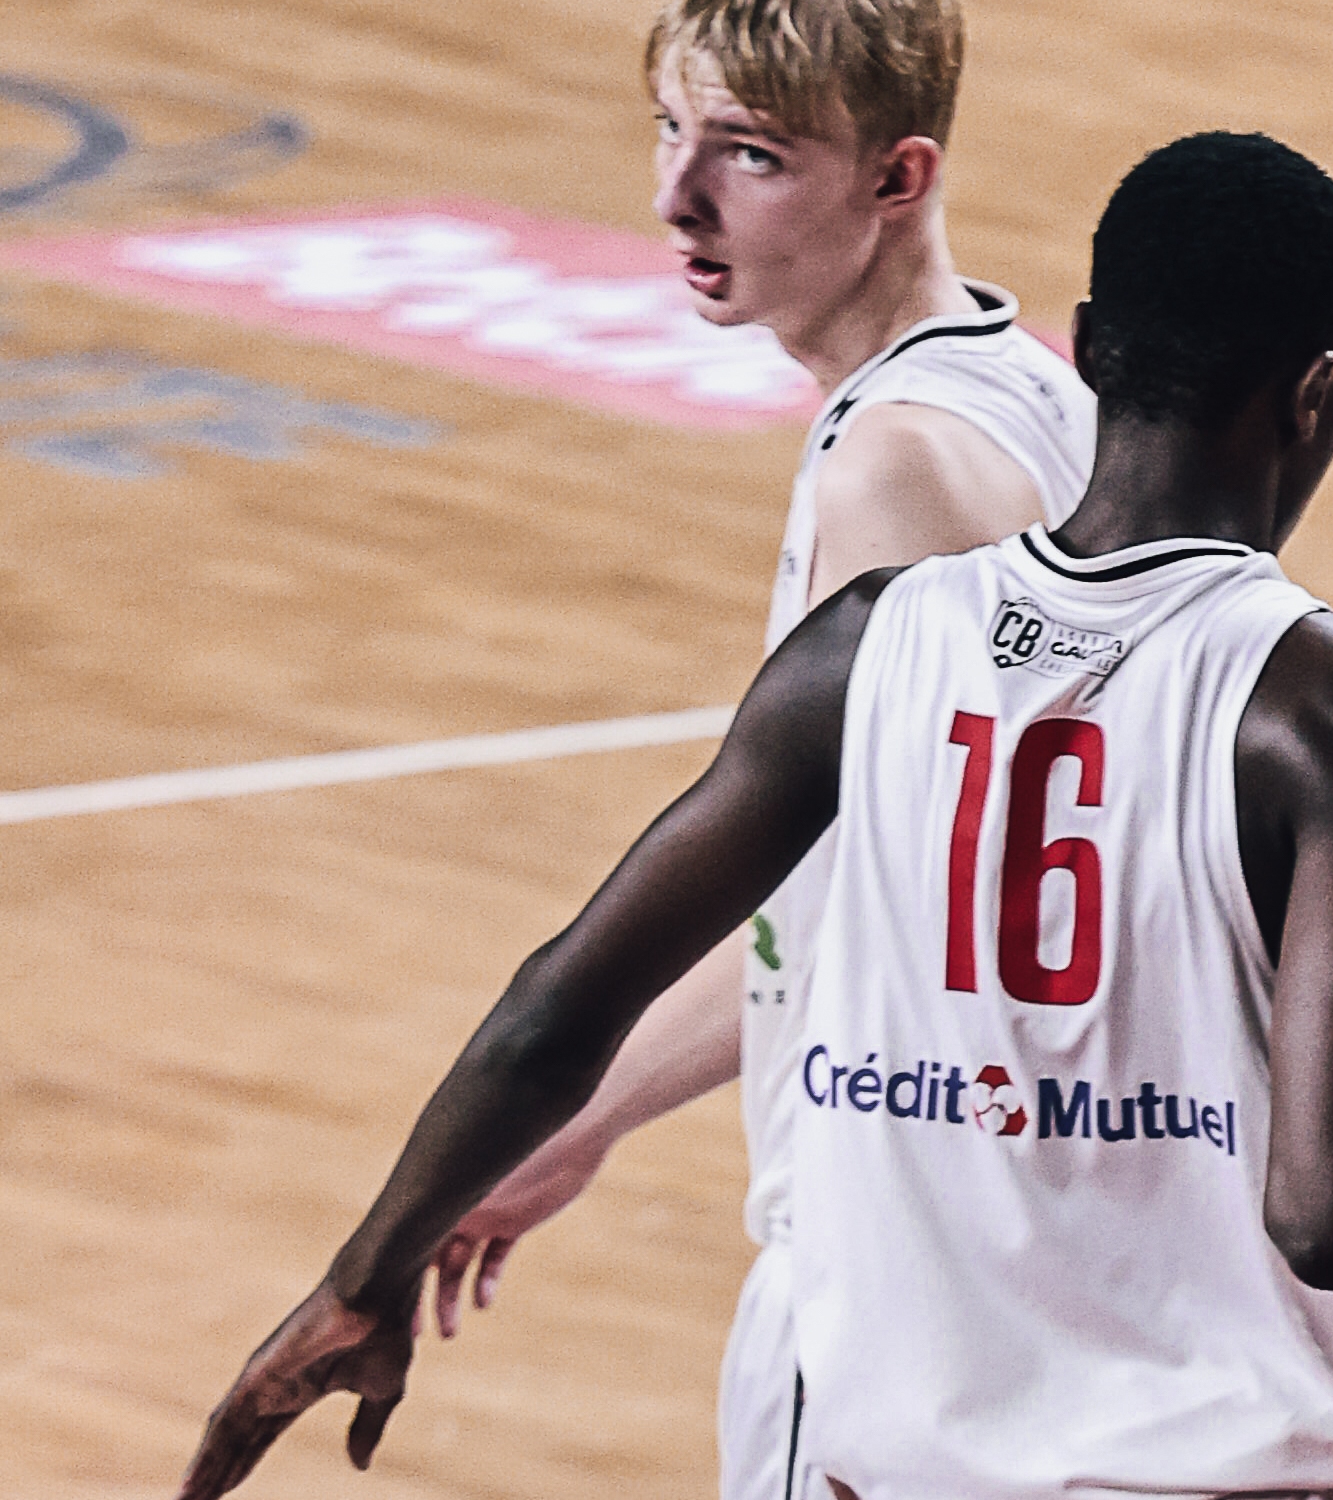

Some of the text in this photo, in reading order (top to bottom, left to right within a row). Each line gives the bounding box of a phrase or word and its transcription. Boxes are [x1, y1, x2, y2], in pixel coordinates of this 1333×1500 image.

[993, 611, 1043, 658] CB
[946, 710, 1106, 1006] 16
[803, 1044, 1236, 1156] Crédit Mutuel
